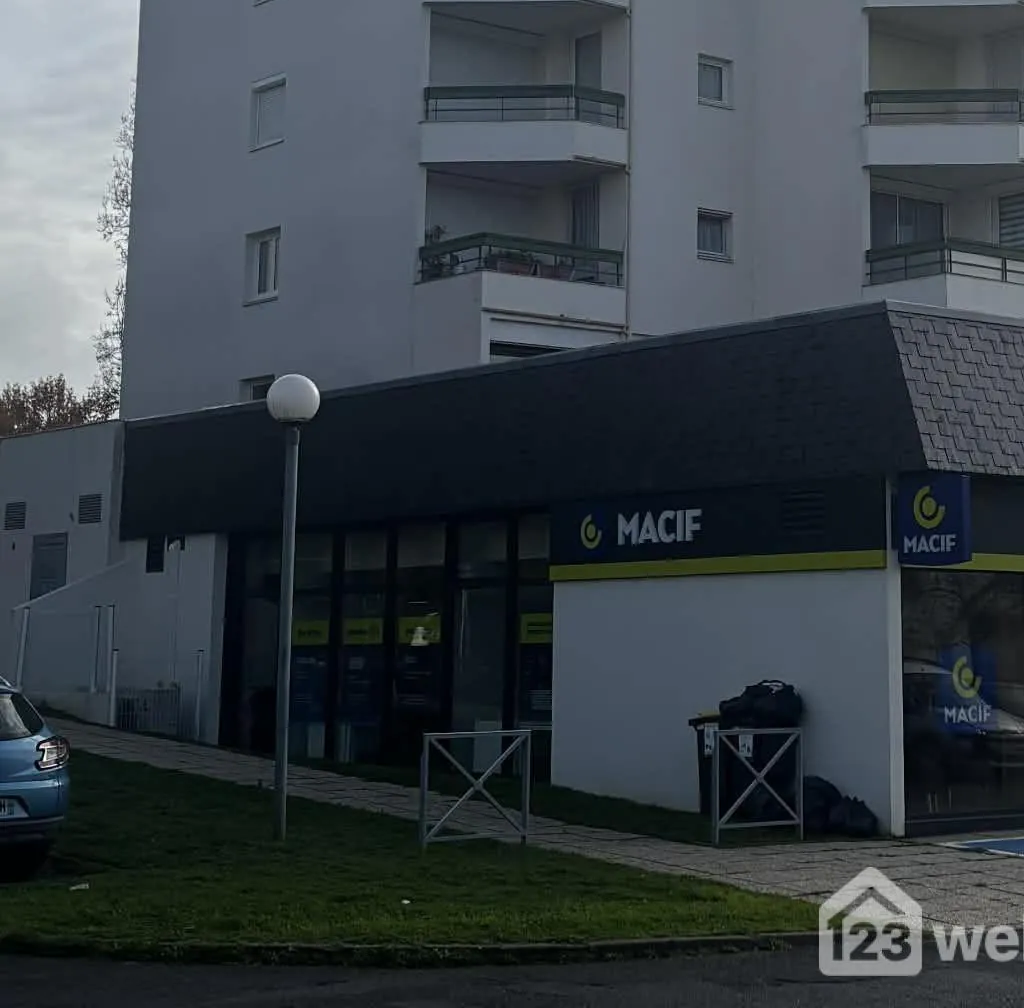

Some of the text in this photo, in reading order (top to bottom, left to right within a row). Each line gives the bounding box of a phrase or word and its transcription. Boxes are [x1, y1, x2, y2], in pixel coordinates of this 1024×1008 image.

[617, 508, 702, 546] MACIF
[903, 533, 956, 554] MACIF
[943, 704, 992, 724] MACIF
